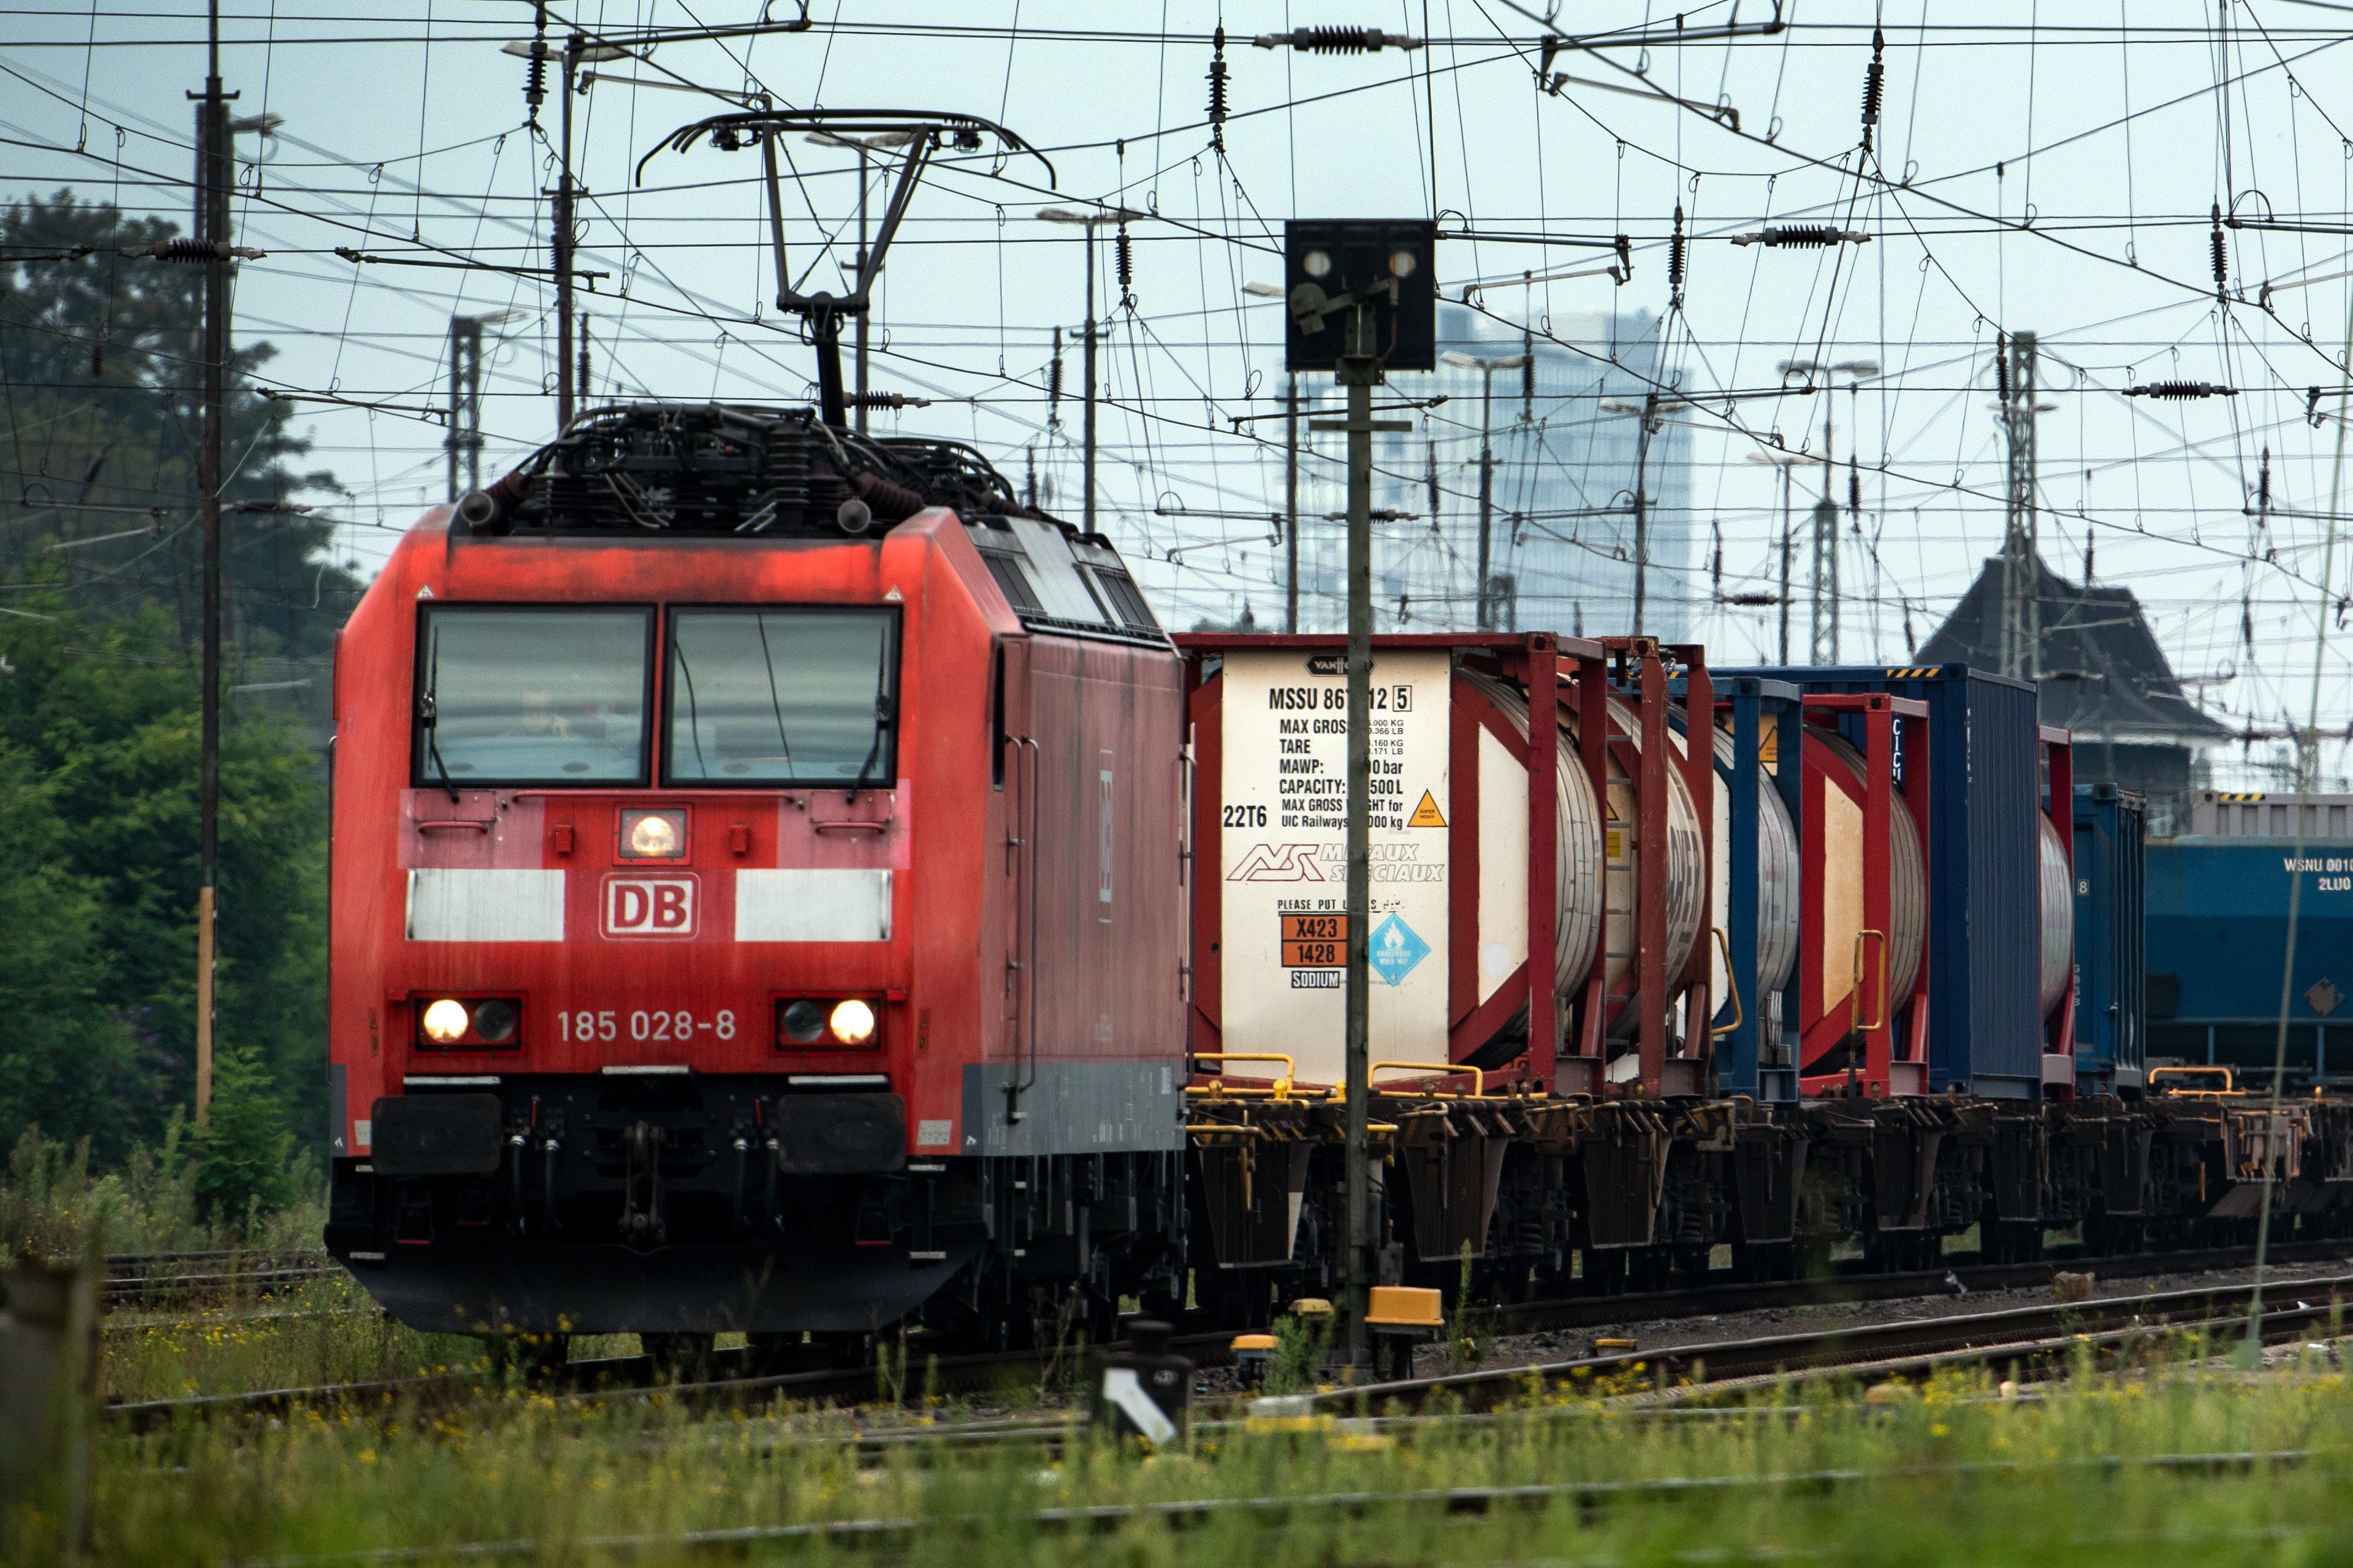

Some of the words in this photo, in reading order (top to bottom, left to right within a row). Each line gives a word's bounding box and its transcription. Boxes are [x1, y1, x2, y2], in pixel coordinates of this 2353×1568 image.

[1269, 687, 1317, 710] MSSU
[1396, 687, 1408, 710] 5
[1280, 719, 1309, 734] MAX
[1313, 719, 1348, 734] GROS
[1279, 739, 1310, 754] TARE
[1279, 759, 1324, 774] MAWP:
[1383, 759, 1403, 775] bar
[1279, 779, 1346, 794] CAPACITY:
[1282, 799, 1305, 811] MAX
[1309, 799, 1342, 811] GROSS
[1388, 799, 1403, 811] for
[1223, 805, 1267, 827] 22T6
[1282, 816, 1299, 827] UIC
[1390, 816, 1402, 830] kg
[2283, 858, 2322, 871] WSNU
[610, 882, 690, 930] DB
[1278, 900, 1312, 909] PLEASE
[1318, 900, 1336, 909] PUT
[1296, 918, 1337, 937] X423
[1298, 944, 1335, 963] 1428
[1293, 972, 1339, 987] SODIUM
[558, 1011, 616, 1041] 185
[630, 1010, 736, 1040] 028-8
